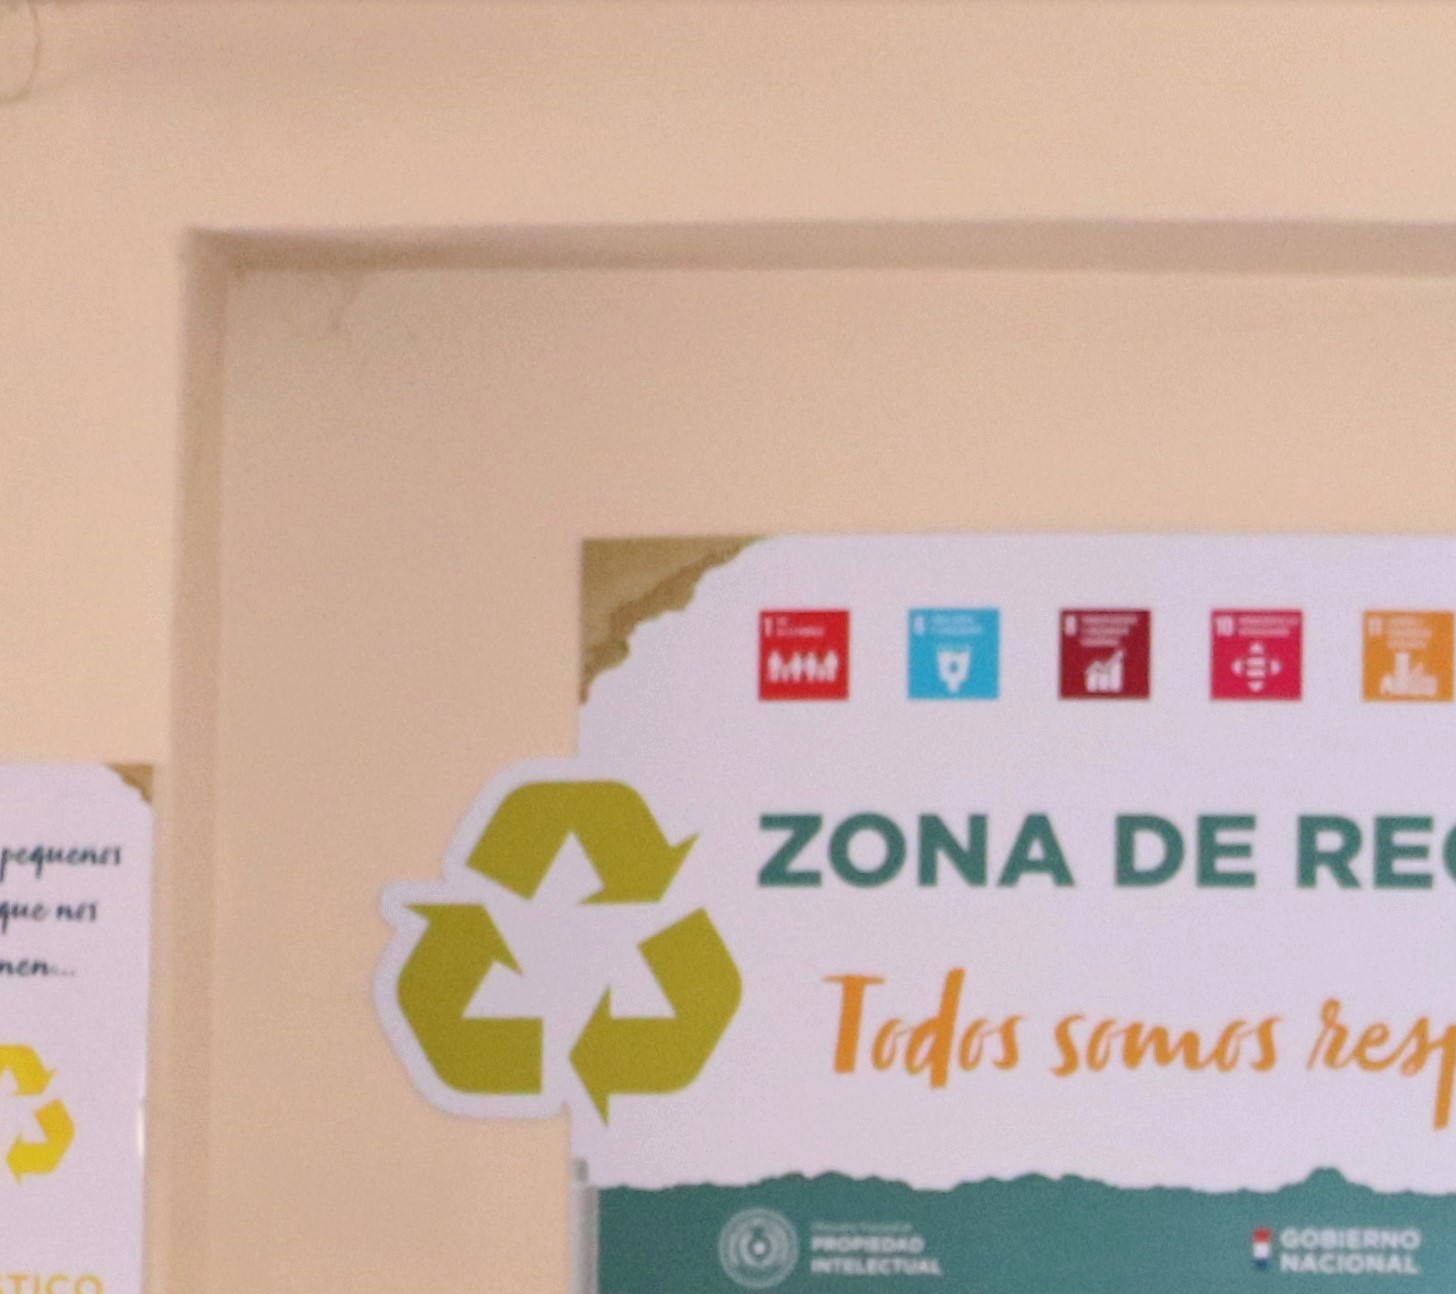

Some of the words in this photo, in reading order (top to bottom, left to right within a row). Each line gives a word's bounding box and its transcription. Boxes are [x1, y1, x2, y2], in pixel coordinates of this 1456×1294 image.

[757, 812, 1075, 888] ZONA
[1114, 814, 1257, 888] DE
[56, 903, 99, 923] nos
[822, 966, 1026, 1090] Todos
[1049, 1013, 1286, 1076] somos
[1279, 1227, 1422, 1249] GOBIERNO
[810, 1257, 942, 1277] INTELECTUAL
[1279, 1252, 1420, 1274] NACIONAL
